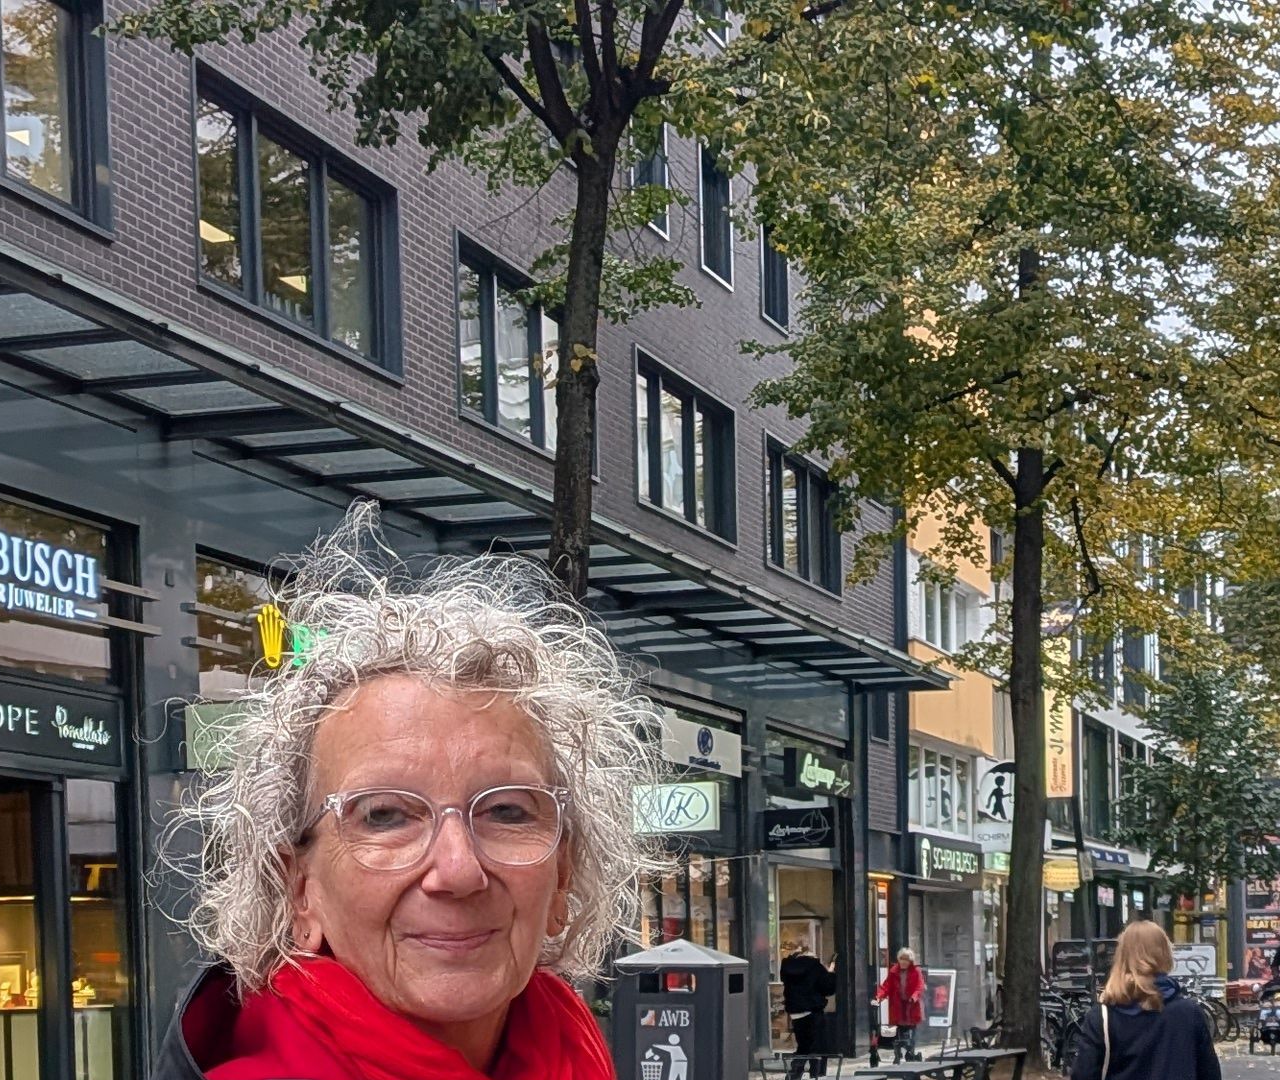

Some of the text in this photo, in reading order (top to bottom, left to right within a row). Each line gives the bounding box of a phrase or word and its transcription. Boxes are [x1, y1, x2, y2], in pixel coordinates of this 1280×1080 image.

[7, 582, 75, 618] JUWELIER
[50, 705, 112, 745] Pomellato
[977, 832, 1010, 841] SCHIRM
[658, 1010, 690, 1027] AWB
